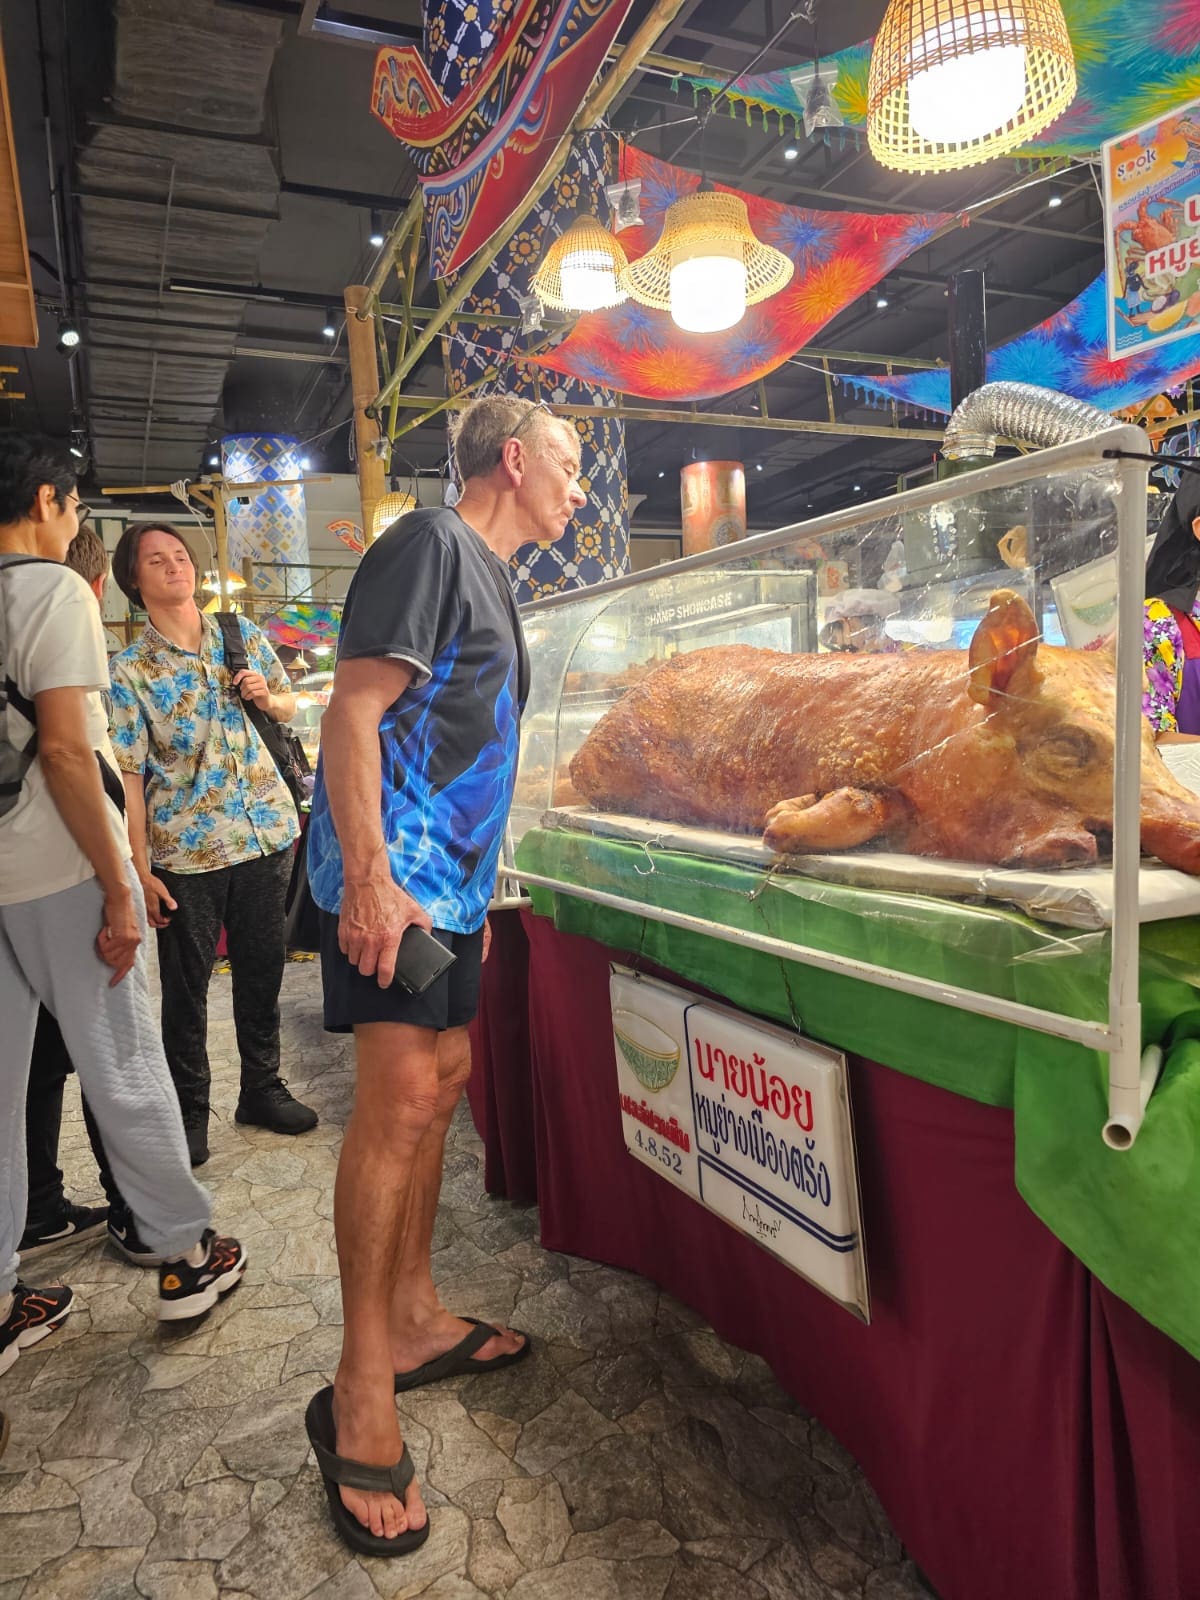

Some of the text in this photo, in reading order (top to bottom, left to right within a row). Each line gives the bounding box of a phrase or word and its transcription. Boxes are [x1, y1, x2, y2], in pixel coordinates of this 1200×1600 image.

[676, 592, 733, 619] SHOWCASE
[695, 1038, 814, 1132] นายน้อย
[635, 1129, 682, 1175] 4.8.52
[695, 1092, 831, 1207] หมูย่างเมืองตรัง
